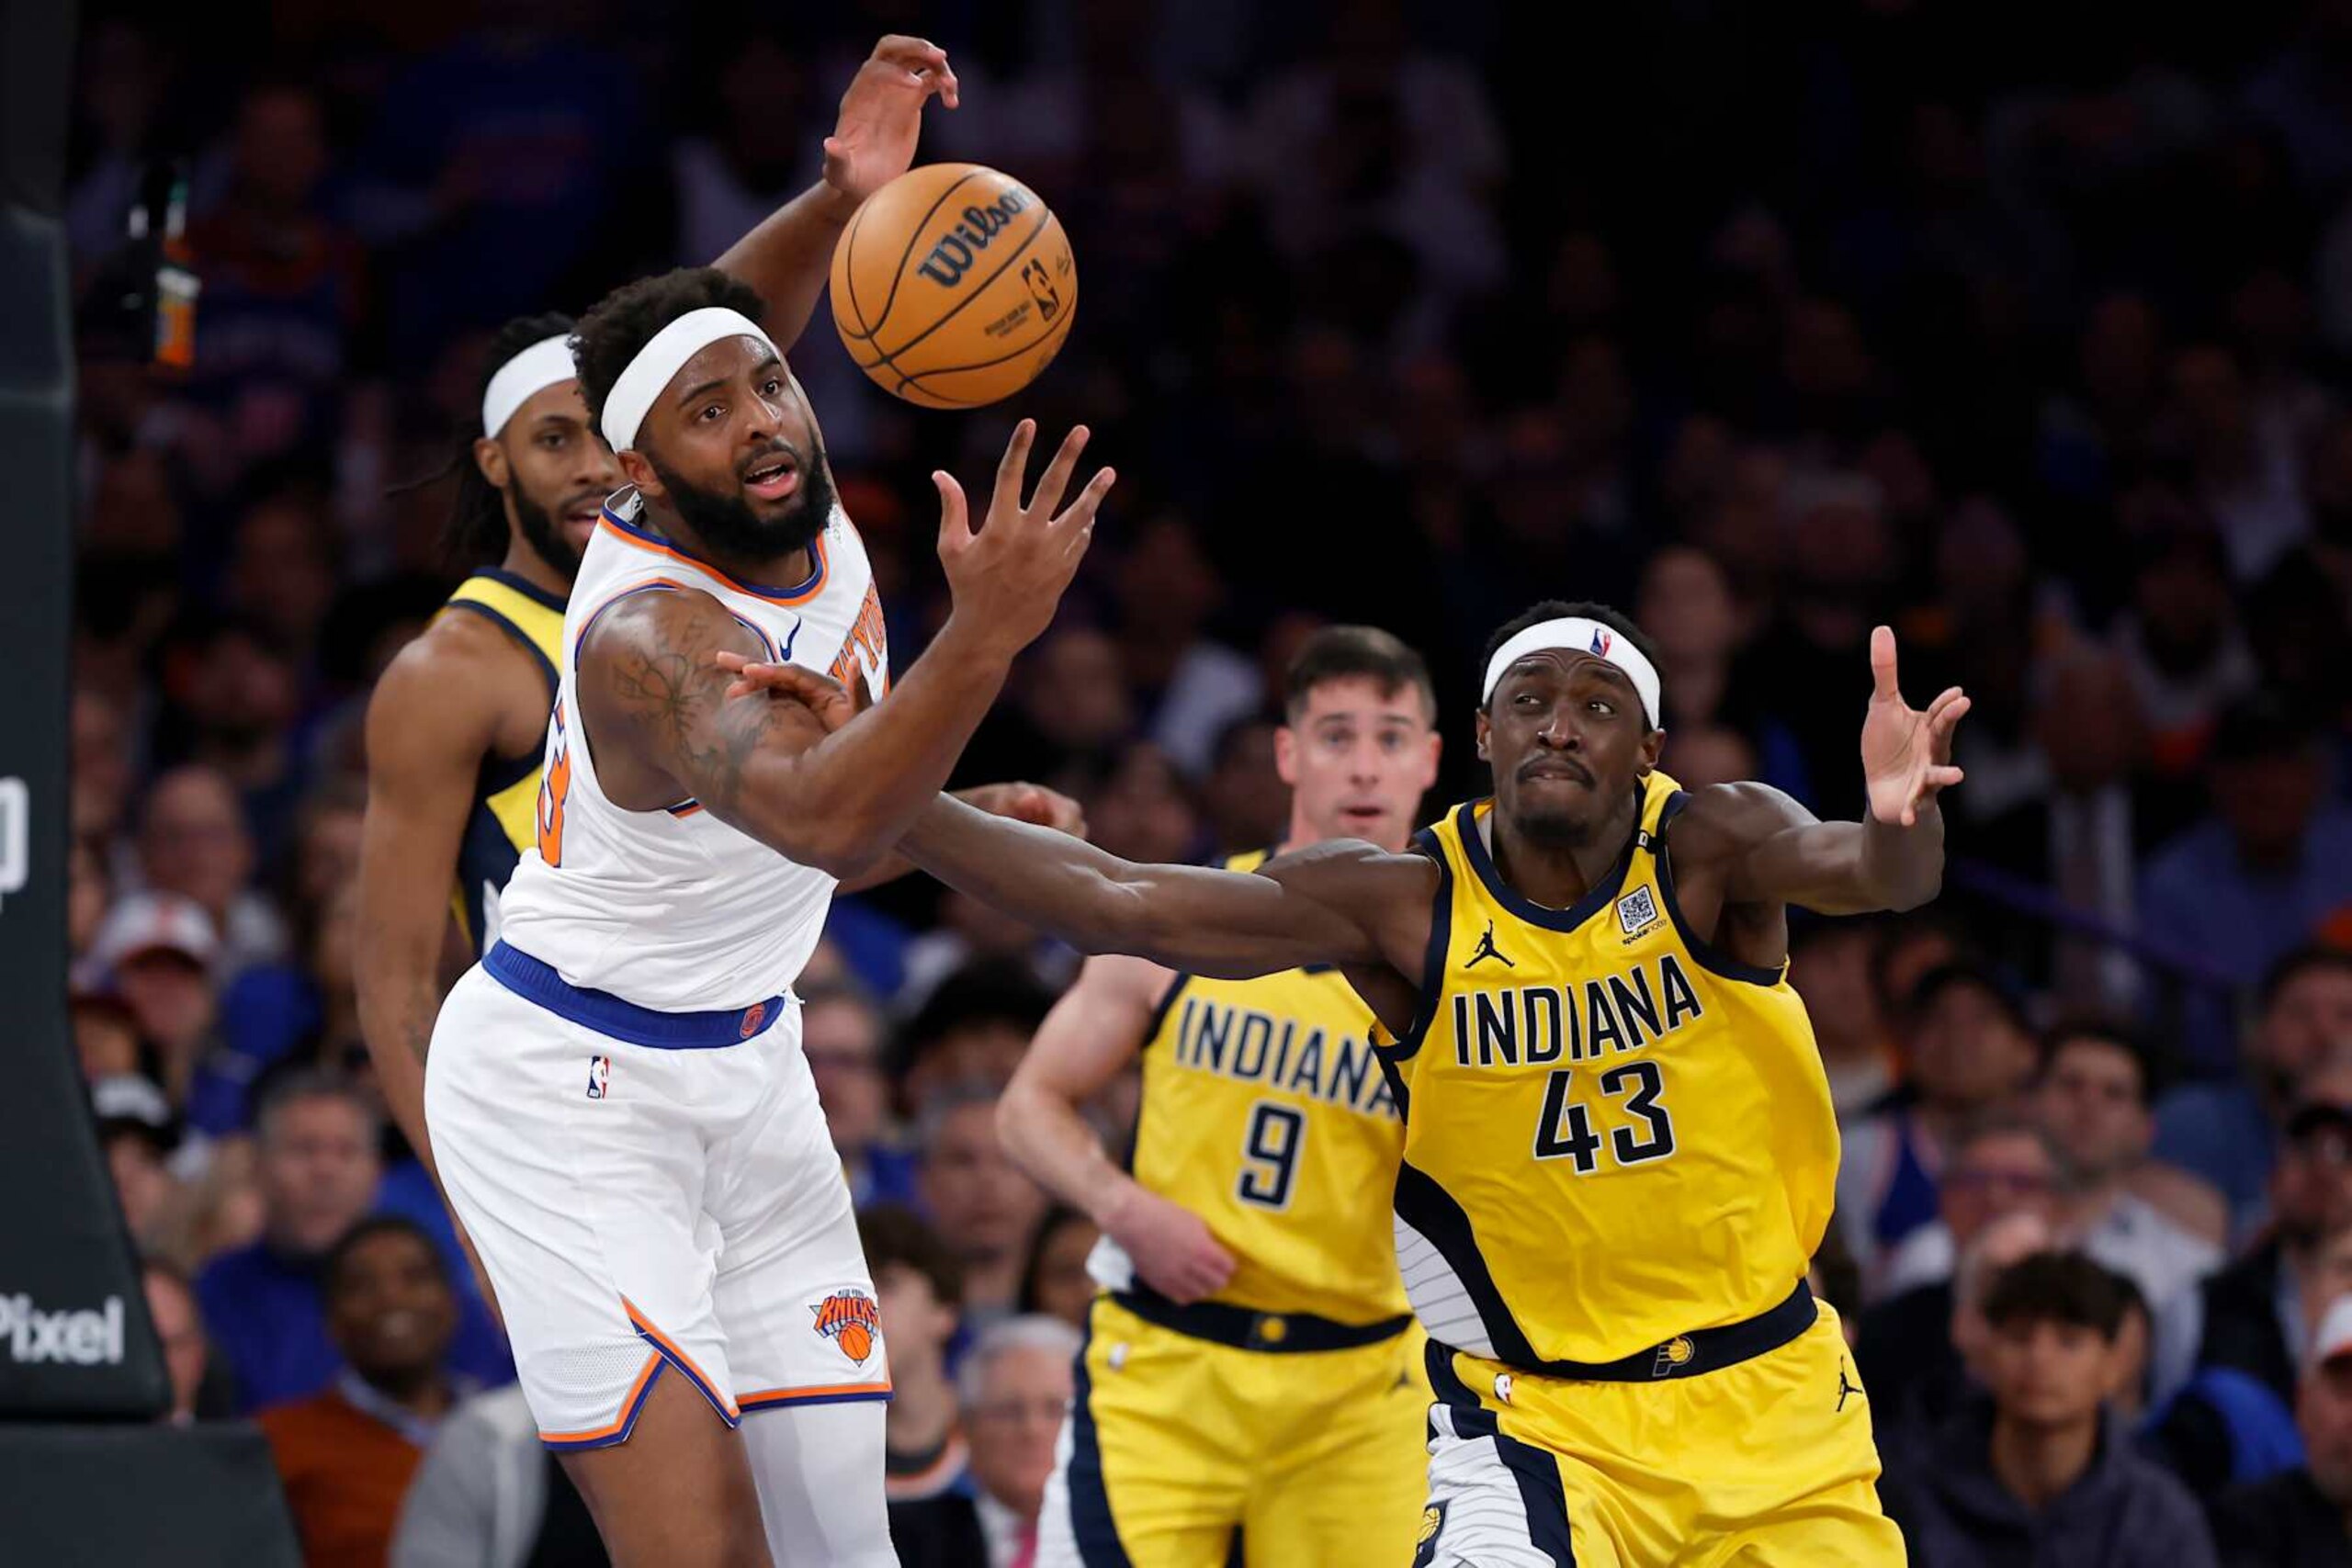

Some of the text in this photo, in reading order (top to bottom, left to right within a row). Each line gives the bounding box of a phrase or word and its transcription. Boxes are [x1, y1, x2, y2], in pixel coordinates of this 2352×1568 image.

[1175, 997, 1401, 1122] INDIANA
[1453, 953, 1702, 1067] INDIANA
[1235, 1100, 1308, 1213] 9
[1533, 1061, 1676, 1177] 43
